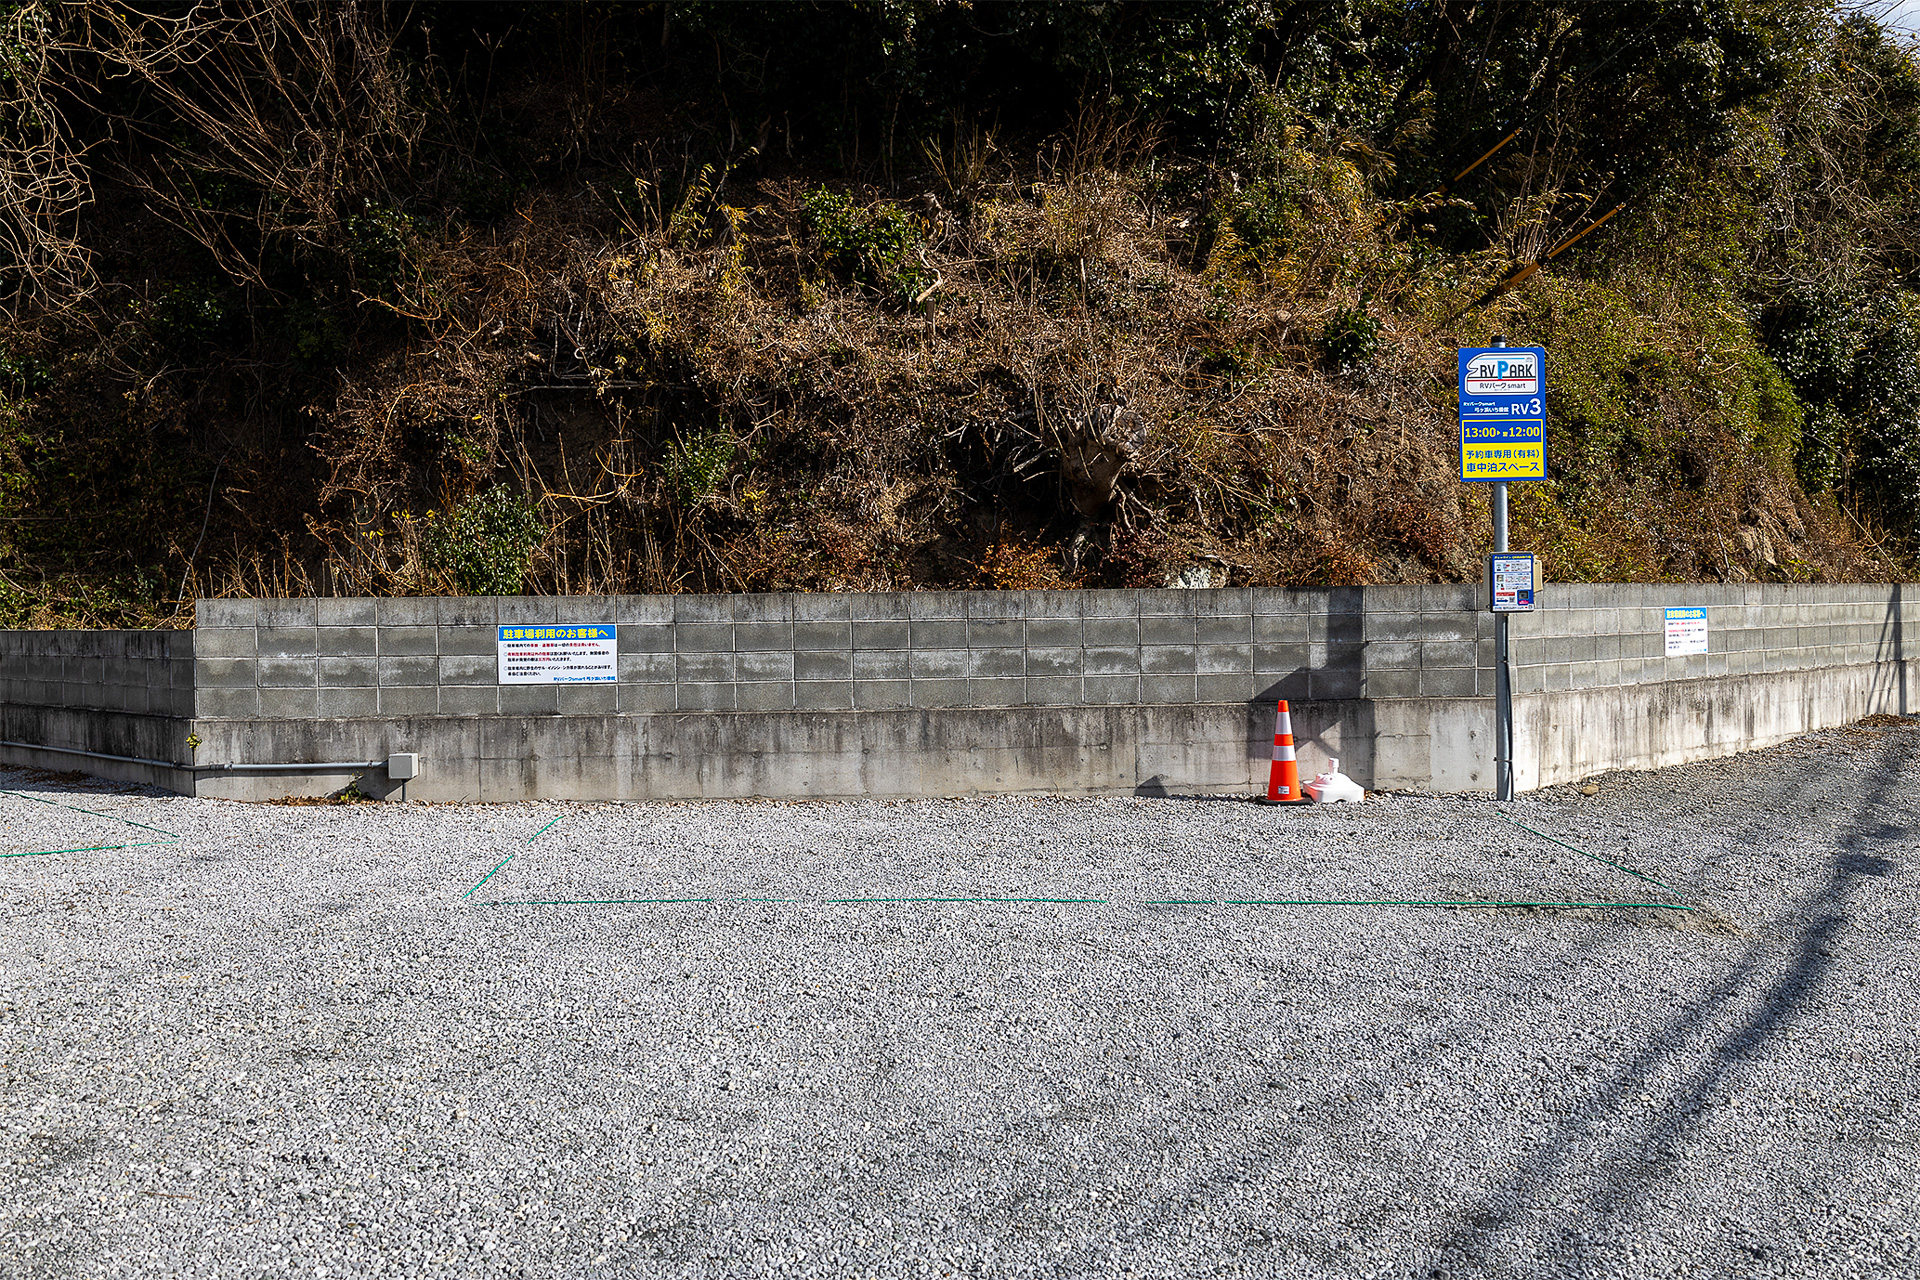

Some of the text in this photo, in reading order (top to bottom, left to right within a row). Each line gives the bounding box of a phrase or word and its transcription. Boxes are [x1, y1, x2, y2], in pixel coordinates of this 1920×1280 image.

[1466, 462, 1540, 473] 車中泊スペース
[503, 628, 609, 639] 駐車場利用のお客様へ
